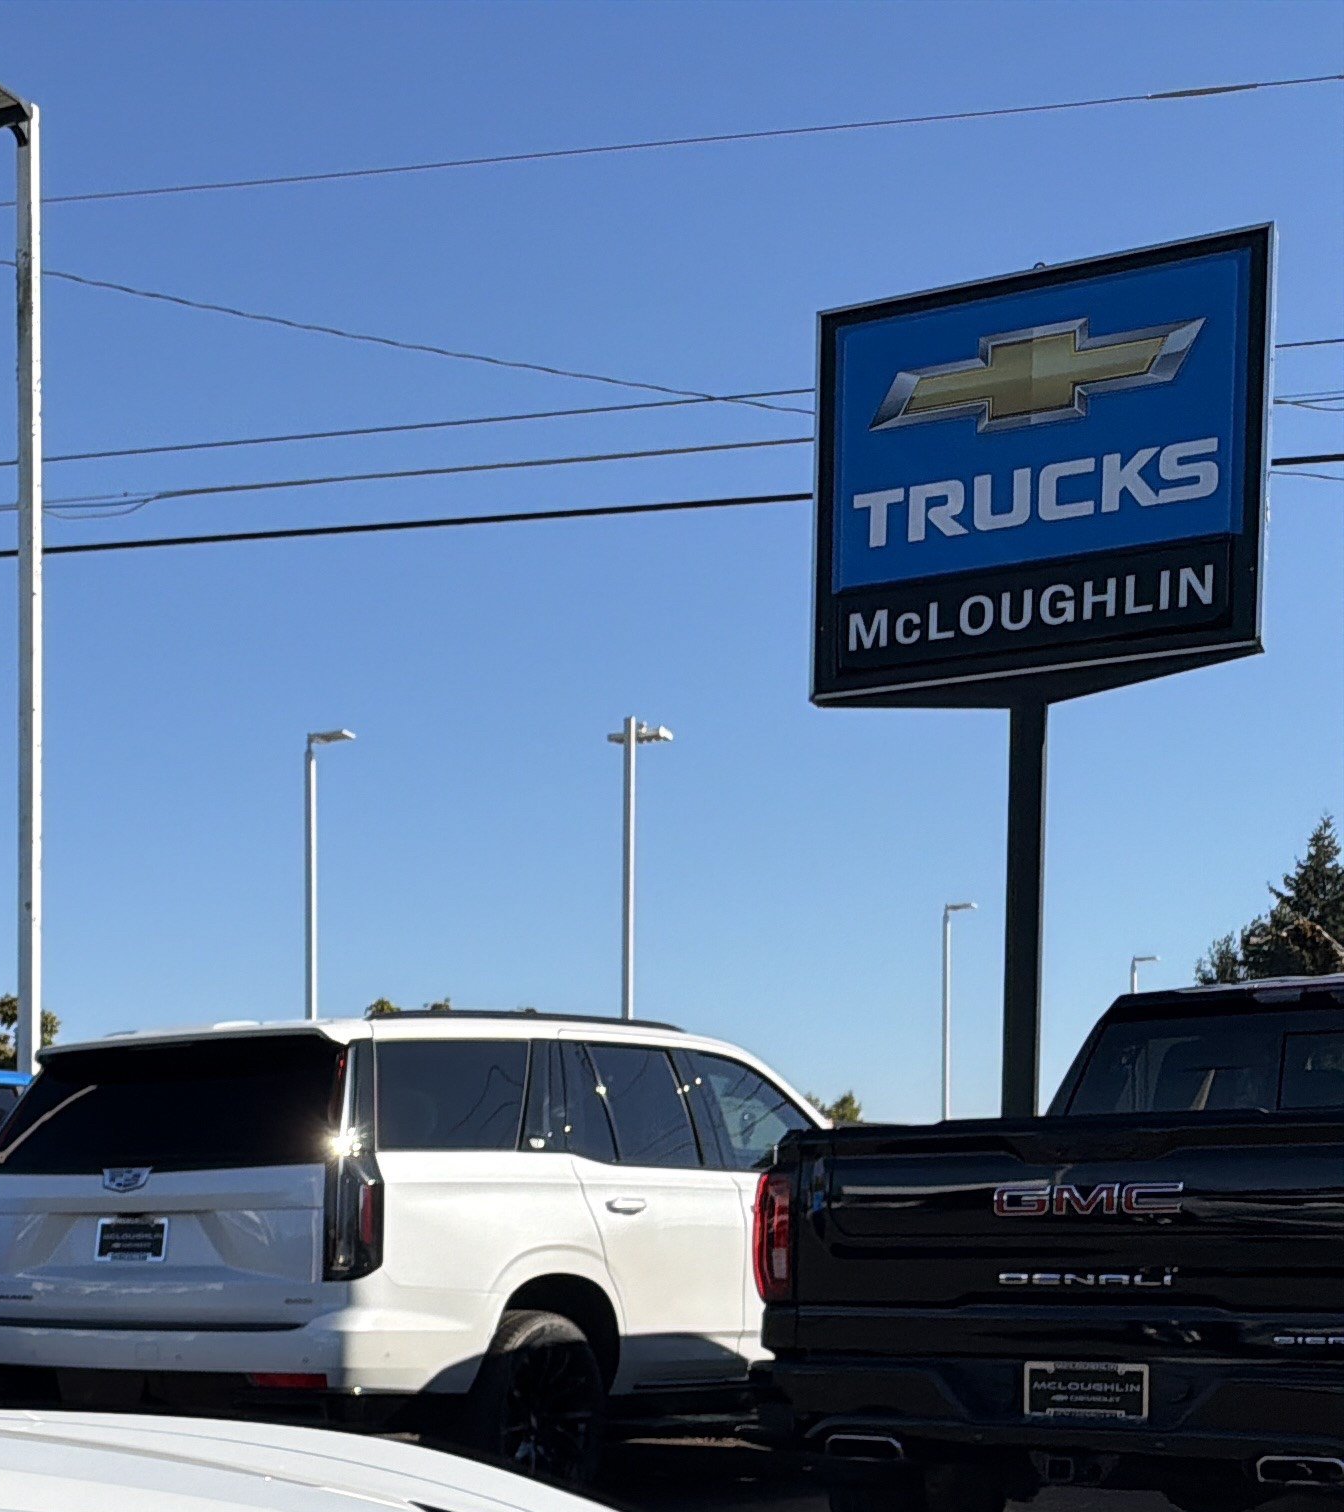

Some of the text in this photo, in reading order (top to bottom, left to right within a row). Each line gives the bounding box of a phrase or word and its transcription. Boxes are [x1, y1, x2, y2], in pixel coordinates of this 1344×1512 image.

[853, 436, 1220, 549] TRUCKS
[847, 564, 1214, 651] McLOUGHLIN
[993, 1181, 1184, 1217] GMC
[998, 1272, 1173, 1287] DENALI
